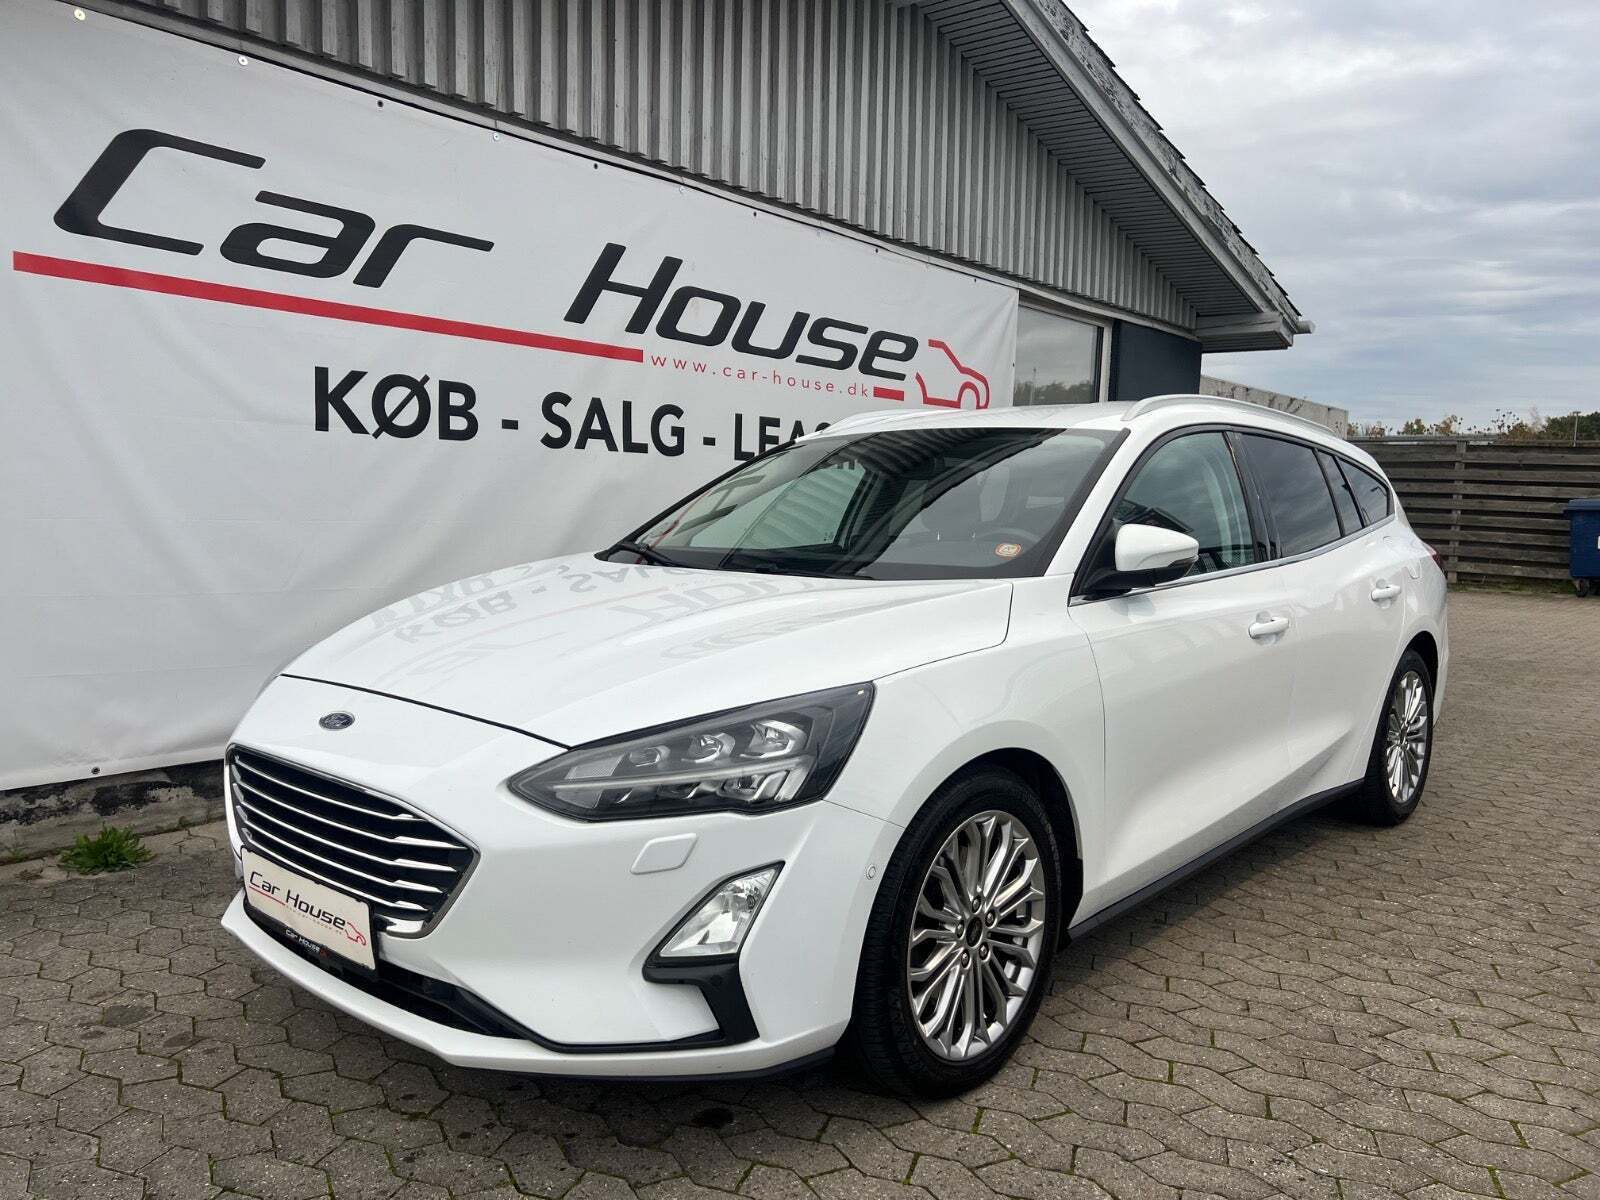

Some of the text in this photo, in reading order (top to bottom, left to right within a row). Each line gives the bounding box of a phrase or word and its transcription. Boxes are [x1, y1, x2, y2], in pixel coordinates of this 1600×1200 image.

[53, 128, 919, 382] Car House
[314, 366, 479, 441] KØB
[540, 391, 685, 457] SALG
[650, 353, 869, 398] www.car-house.dk
[249, 871, 281, 895] Car
[285, 889, 346, 930] House
